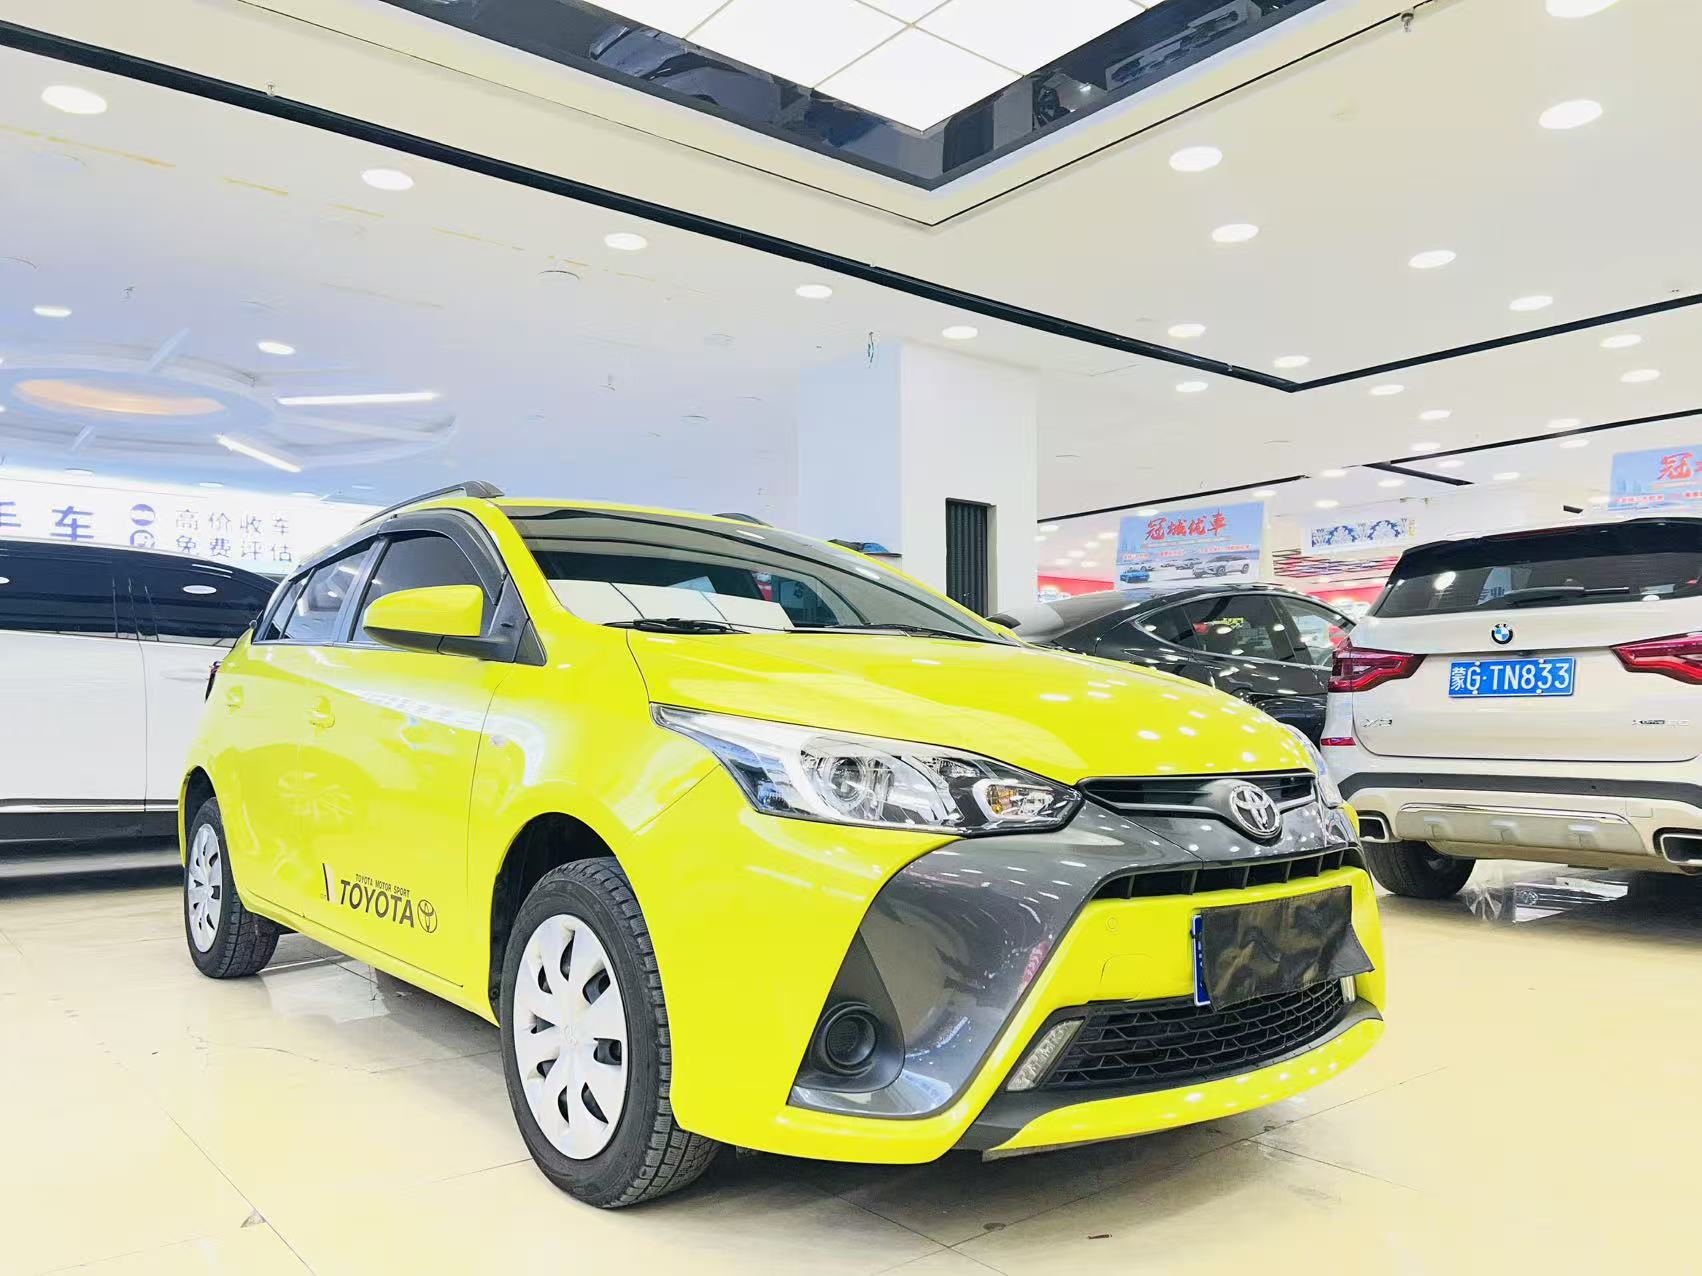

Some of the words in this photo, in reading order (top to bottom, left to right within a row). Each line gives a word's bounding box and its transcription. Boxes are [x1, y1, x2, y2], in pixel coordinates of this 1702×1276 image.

[176, 509, 289, 536] 高价收车
[176, 535, 294, 562] 免费评估
[356, 873, 373, 885] TOYOTA
[375, 879, 391, 891] MOTOR
[393, 885, 409, 897] SPORT
[340, 879, 414, 928] TOYOTA
